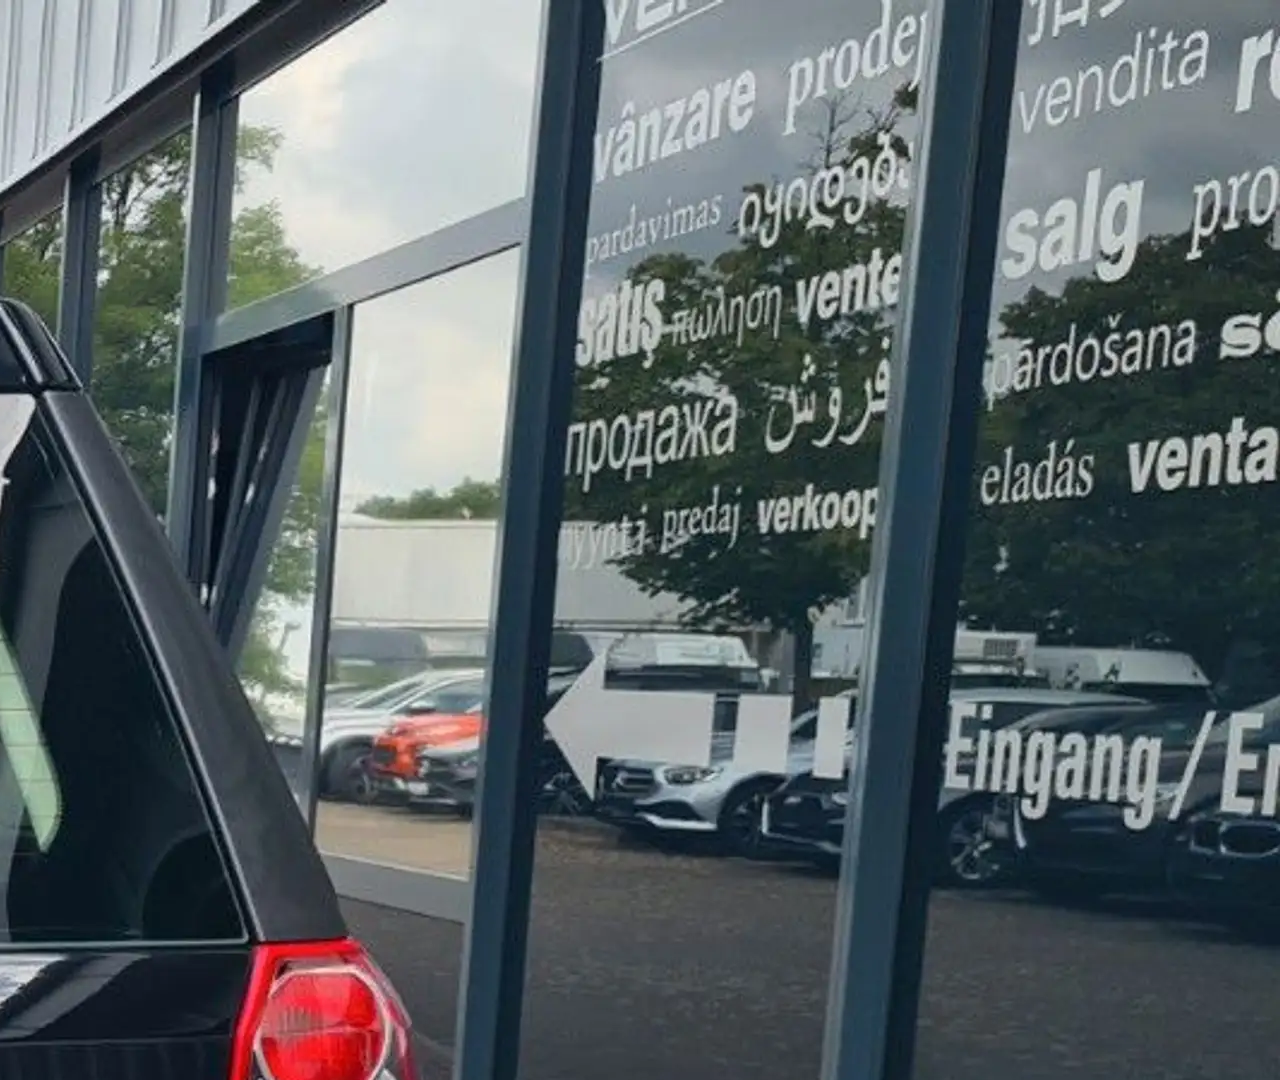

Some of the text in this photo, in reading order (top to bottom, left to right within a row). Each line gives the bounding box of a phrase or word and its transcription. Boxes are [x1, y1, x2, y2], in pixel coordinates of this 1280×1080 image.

[594, 69, 756, 184] vânzare
[1018, 27, 1209, 134] vendita
[1001, 168, 1145, 282] salg
[795, 247, 903, 332] vente
[564, 394, 738, 493] продажа
[980, 416, 1279, 506] eladás venta
[659, 484, 743, 554] predaj
[943, 701, 1162, 830] Eingang
